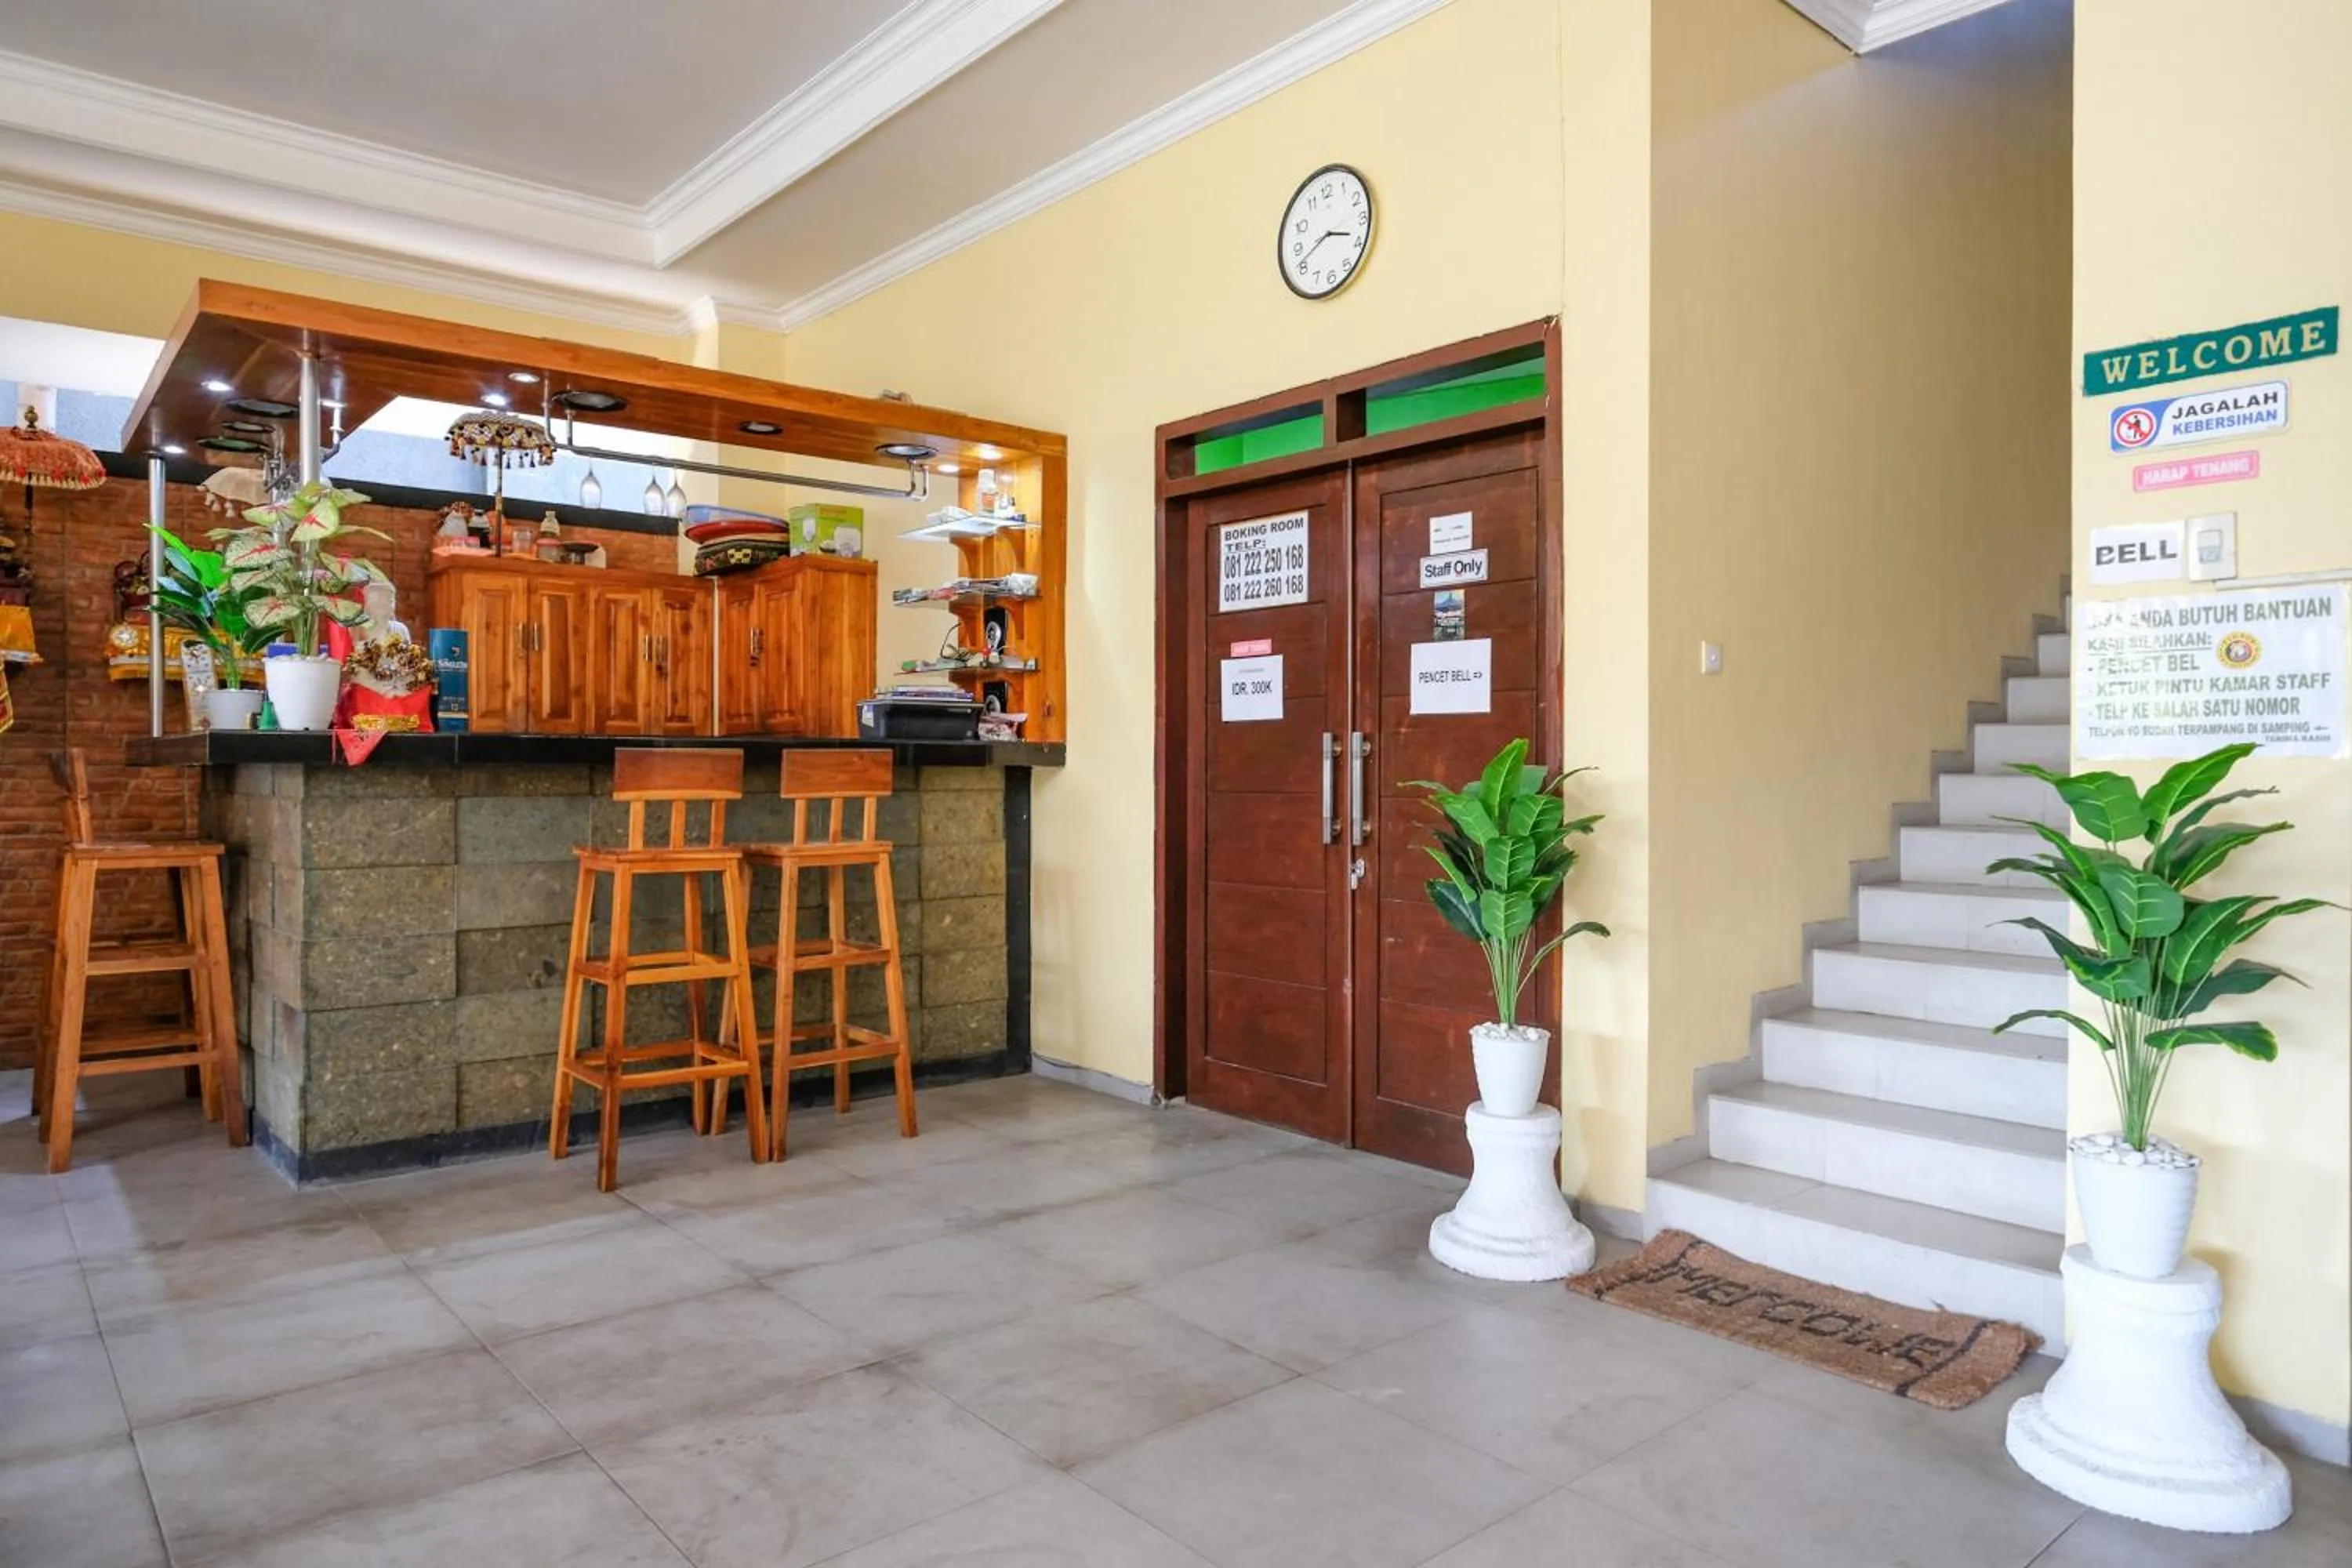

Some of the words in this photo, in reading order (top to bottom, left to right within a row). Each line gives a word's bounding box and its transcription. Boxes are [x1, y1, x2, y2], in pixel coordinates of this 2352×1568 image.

[1321, 184, 1334, 199] 12
[1341, 182, 1346, 194] 1
[1308, 196, 1316, 211] 11
[1352, 191, 1361, 207] 2
[1359, 211, 1367, 226] 3
[1294, 242, 1303, 256] 9
[1355, 236, 1363, 249] 4
[1299, 261, 1308, 274] 8
[1342, 259, 1352, 272] 5
[1312, 270, 1320, 285] 7
[1327, 270, 1336, 284] 6
[2101, 320, 2327, 384] WELCOME
[2171, 392, 2278, 419] JAGALAH
[2172, 408, 2278, 436] KEBERSIHAN
[1225, 524, 1267, 541] BOKING
[1271, 517, 1304, 533] ROOM
[2095, 539, 2178, 566] BELL
[1225, 554, 1241, 579] 081
[1244, 550, 1261, 575] 222
[1264, 547, 1282, 573] 250
[1286, 543, 1304, 571] 168
[1425, 561, 1452, 578] Staff
[1454, 558, 1483, 575] Only
[1225, 583, 1241, 602] 081
[1244, 579, 1261, 600] 222
[1286, 574, 1304, 595] 168
[2179, 604, 2238, 626] BUTUH
[2244, 597, 2332, 622] BANTUAN
[2167, 654, 2200, 672] BEL
[1418, 670, 1450, 684] PENCET
[1451, 670, 1472, 682] BELL
[2155, 678, 2203, 695] PINTU
[2209, 675, 2270, 692] KAMAR
[2276, 673, 2332, 690] STAFF
[1250, 679, 1272, 695] 300K
[2203, 699, 2240, 717] SATU
[2245, 697, 2300, 716] NOMOR
[2178, 723, 2245, 735] TERPAMPANG
[2248, 723, 2258, 735] DI
[2261, 721, 2310, 734] SAMPING
